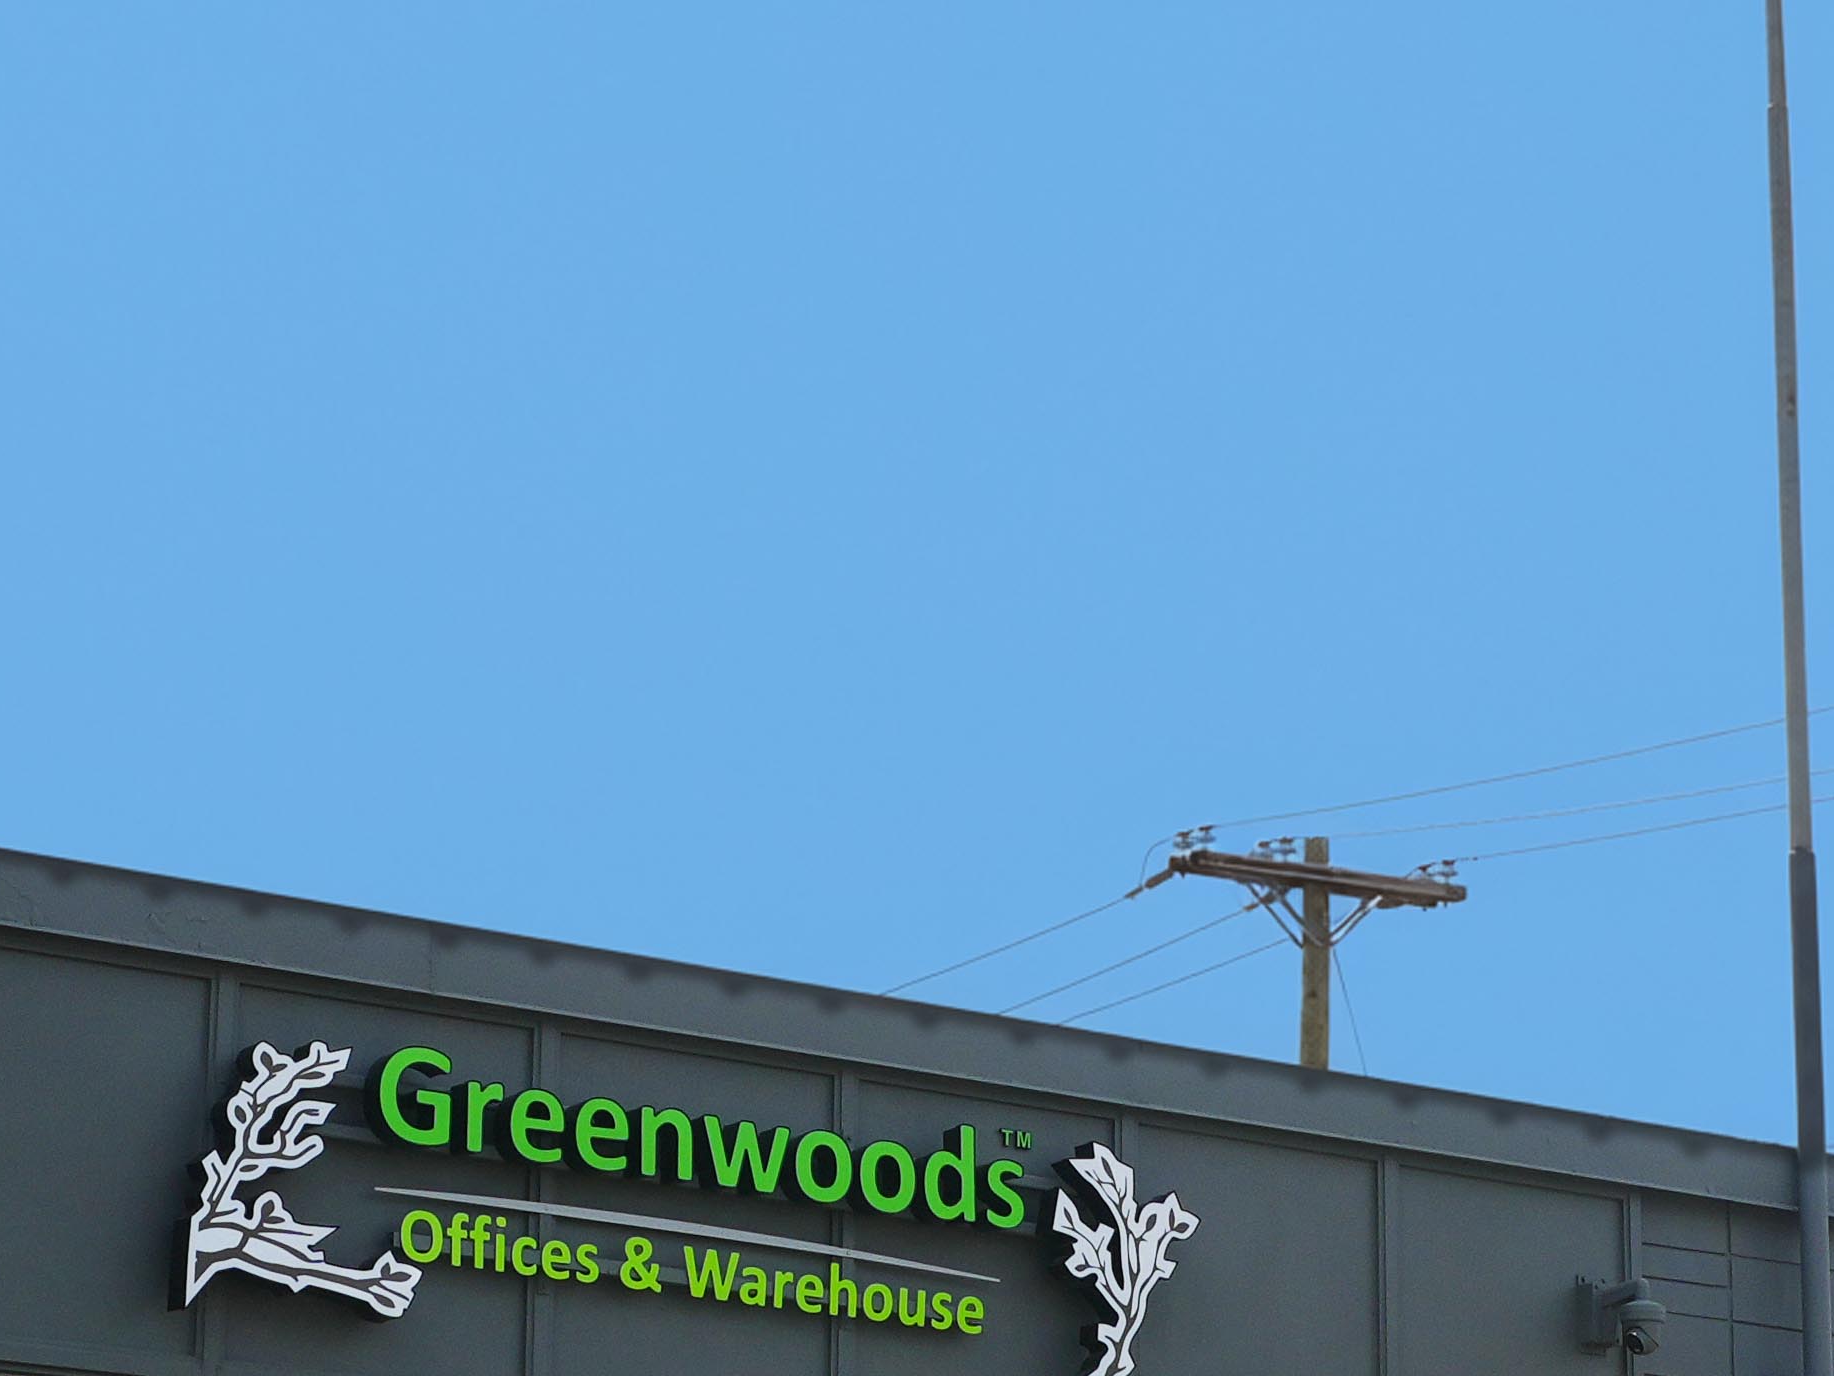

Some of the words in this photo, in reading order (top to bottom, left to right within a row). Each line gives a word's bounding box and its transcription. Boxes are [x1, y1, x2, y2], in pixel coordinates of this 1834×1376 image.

[379, 1046, 1026, 1229] Greenwoods
[400, 1208, 601, 1285] Offices
[620, 1235, 663, 1293] &
[684, 1246, 986, 1336] Warehouse
